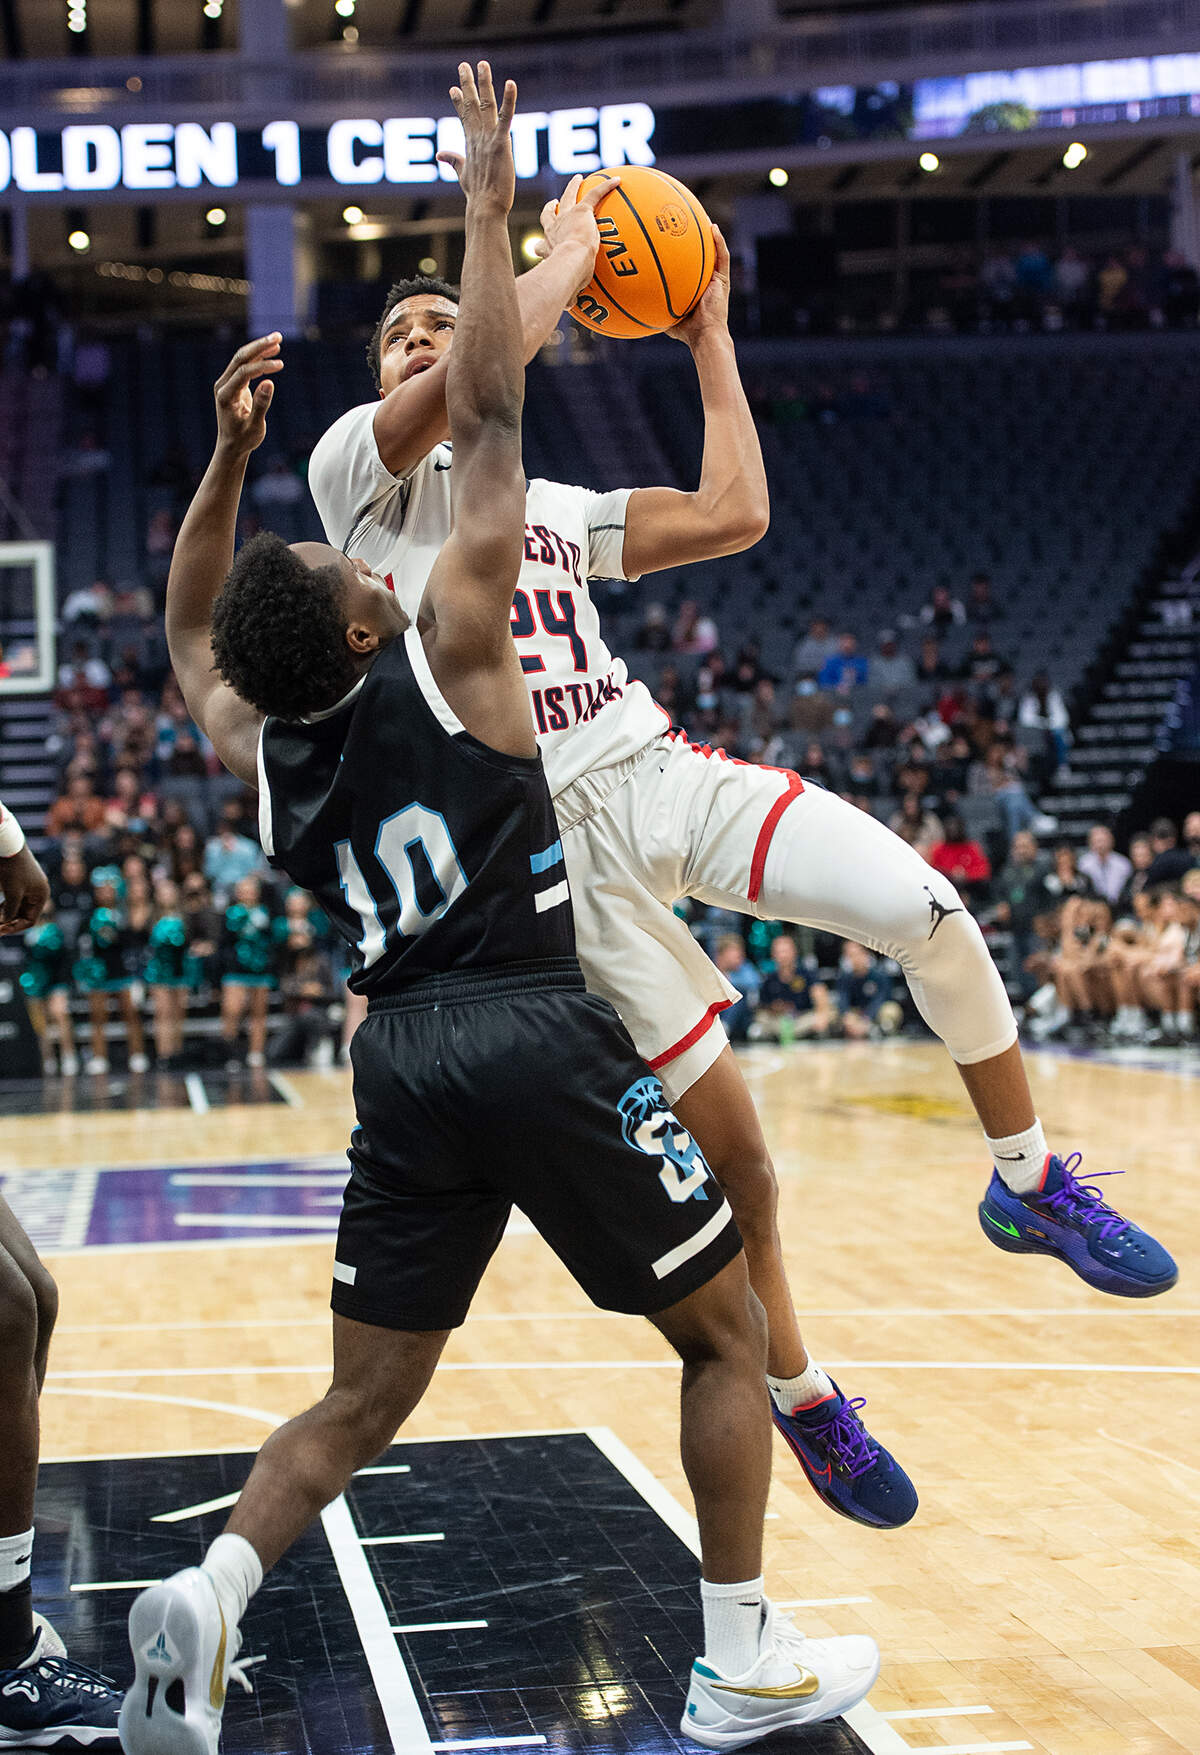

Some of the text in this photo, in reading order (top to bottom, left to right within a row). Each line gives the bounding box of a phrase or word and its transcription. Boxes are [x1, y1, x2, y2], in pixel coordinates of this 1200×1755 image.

[0, 121, 239, 192] LDEN
[262, 120, 301, 186] 1
[508, 588, 588, 674] 24
[333, 801, 471, 970] 10
